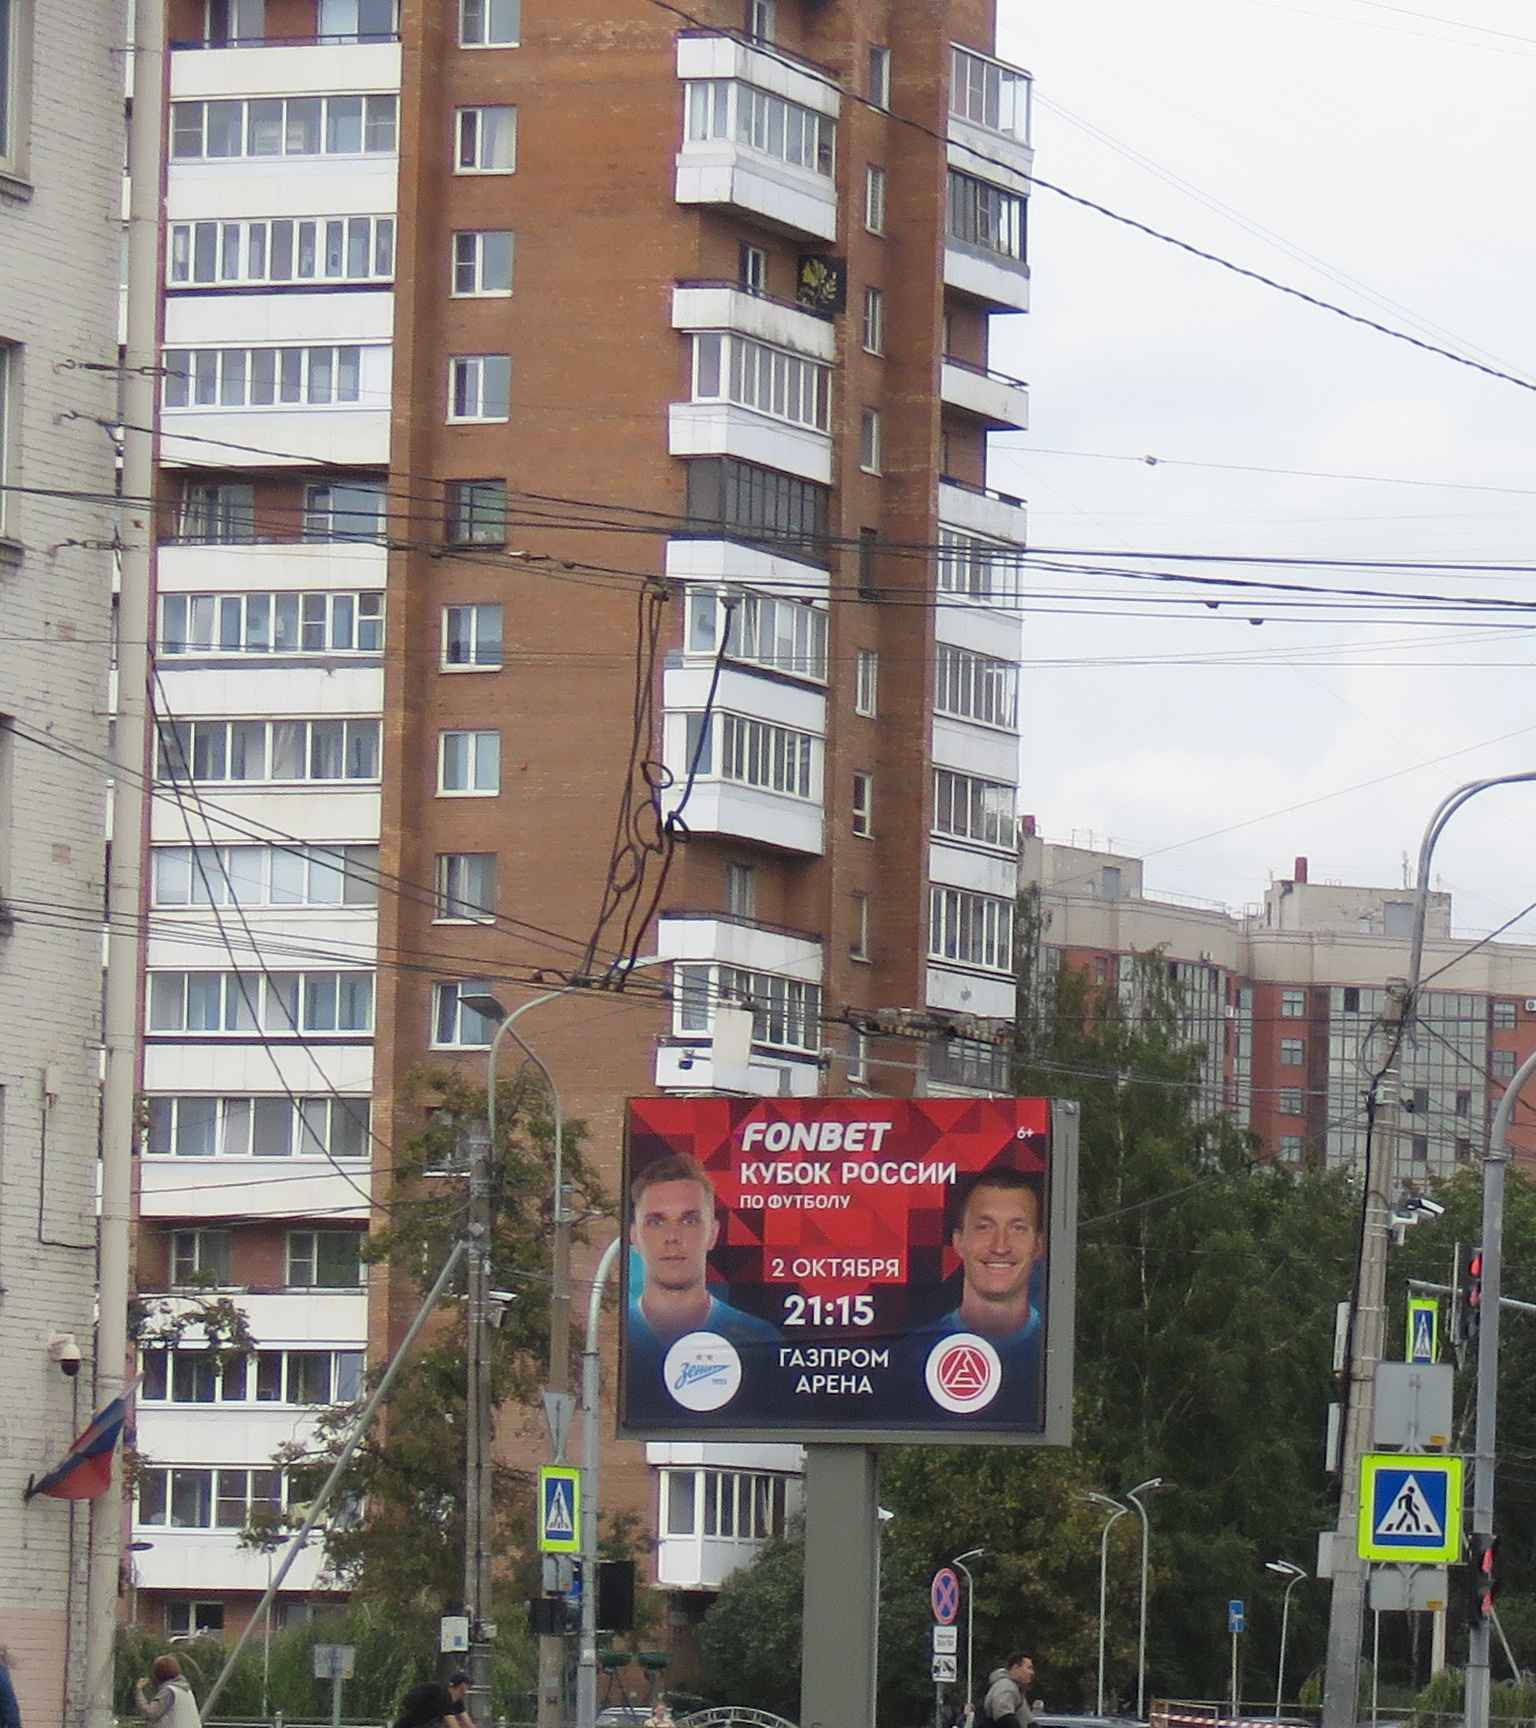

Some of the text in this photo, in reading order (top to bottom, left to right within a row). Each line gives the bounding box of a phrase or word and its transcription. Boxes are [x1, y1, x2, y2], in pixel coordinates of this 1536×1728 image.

[741, 1122, 892, 1152] FONBET
[1016, 1126, 1035, 1140] 6+
[740, 1162, 957, 1185] КУБОК РОССИИ
[739, 1194, 850, 1209] ПО ФУТБОЛУ
[771, 1258, 900, 1278] 2 ОКТЯБРЯ
[783, 1294, 875, 1327] 21:15
[779, 1348, 889, 1368] ГАЗПРОМ
[795, 1374, 873, 1394] АРЕНА
